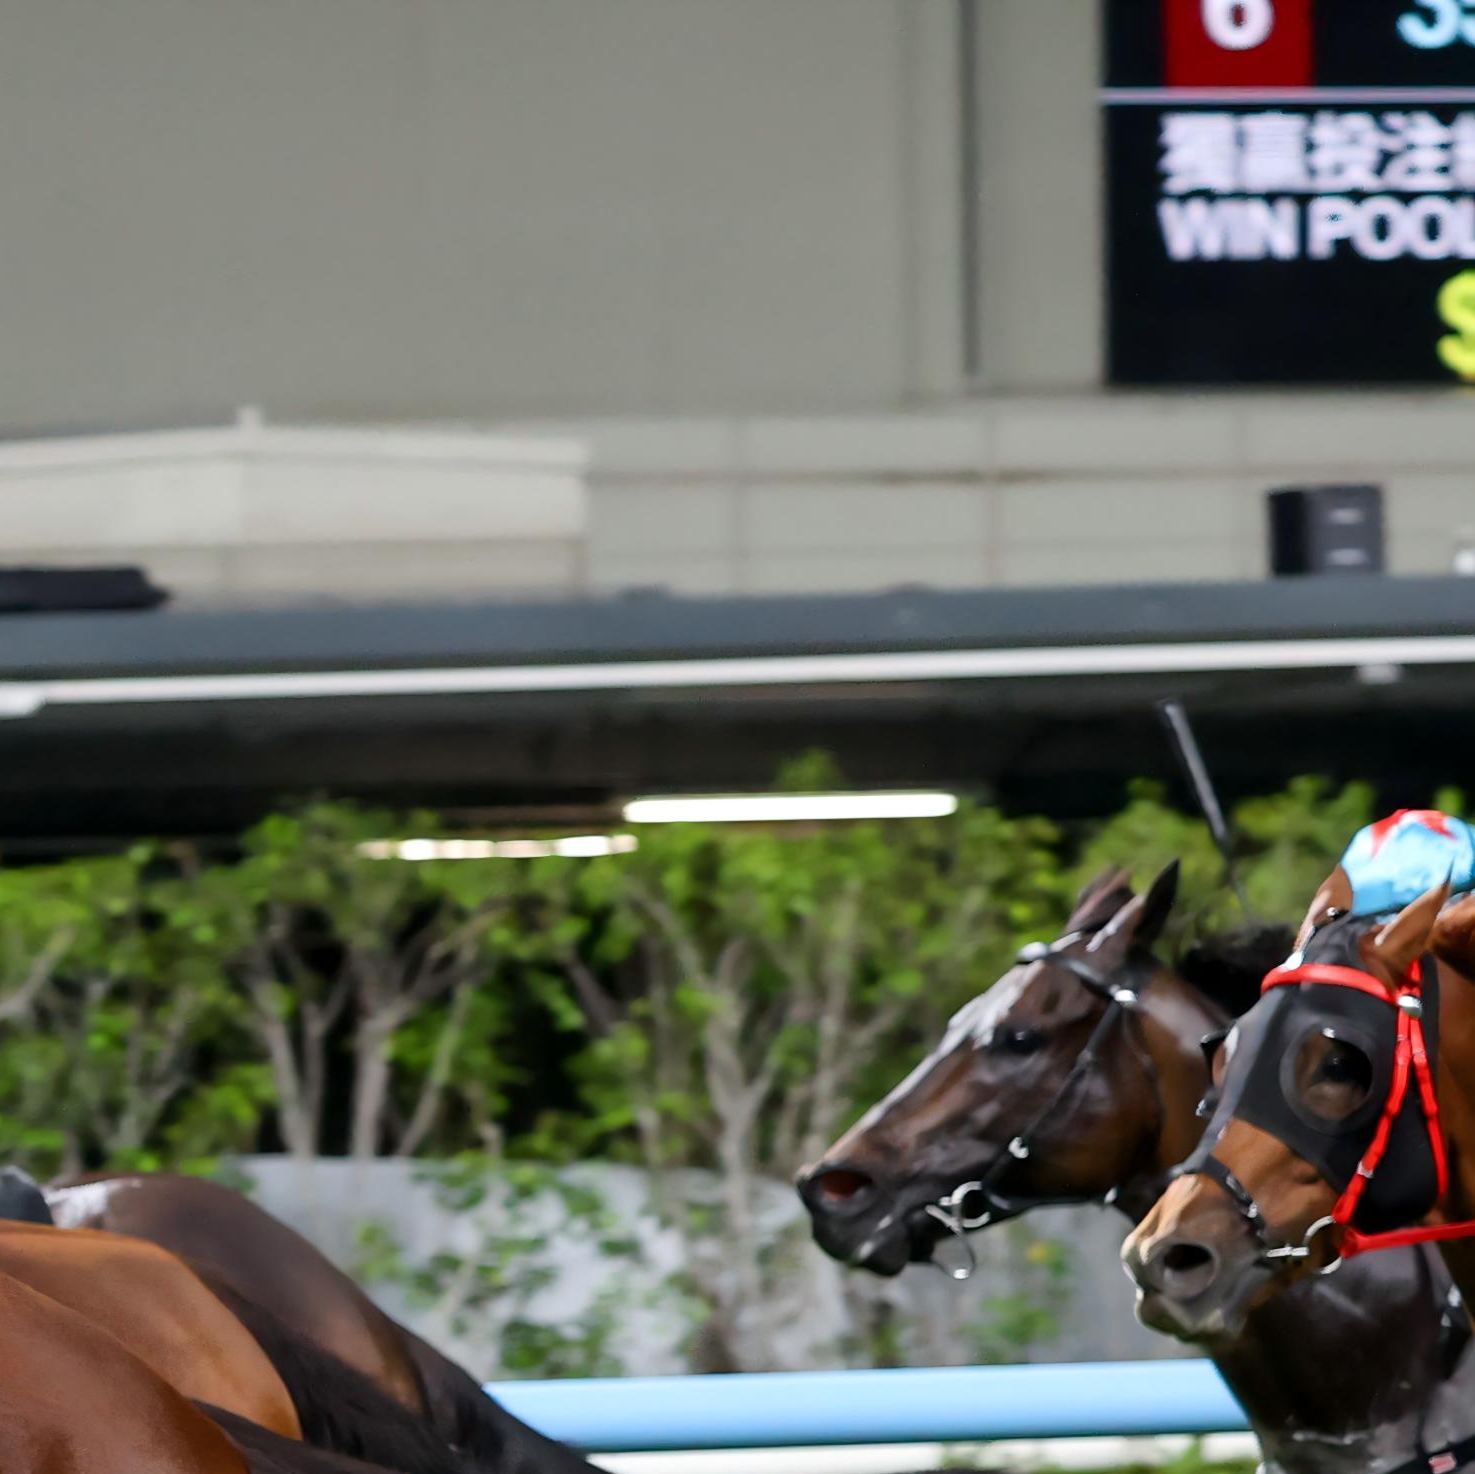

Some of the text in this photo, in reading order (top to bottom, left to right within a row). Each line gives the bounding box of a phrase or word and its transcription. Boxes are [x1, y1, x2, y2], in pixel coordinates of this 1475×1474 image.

[1158, 112, 1475, 195] 獨贏投注
[1157, 197, 1300, 261] WIN
